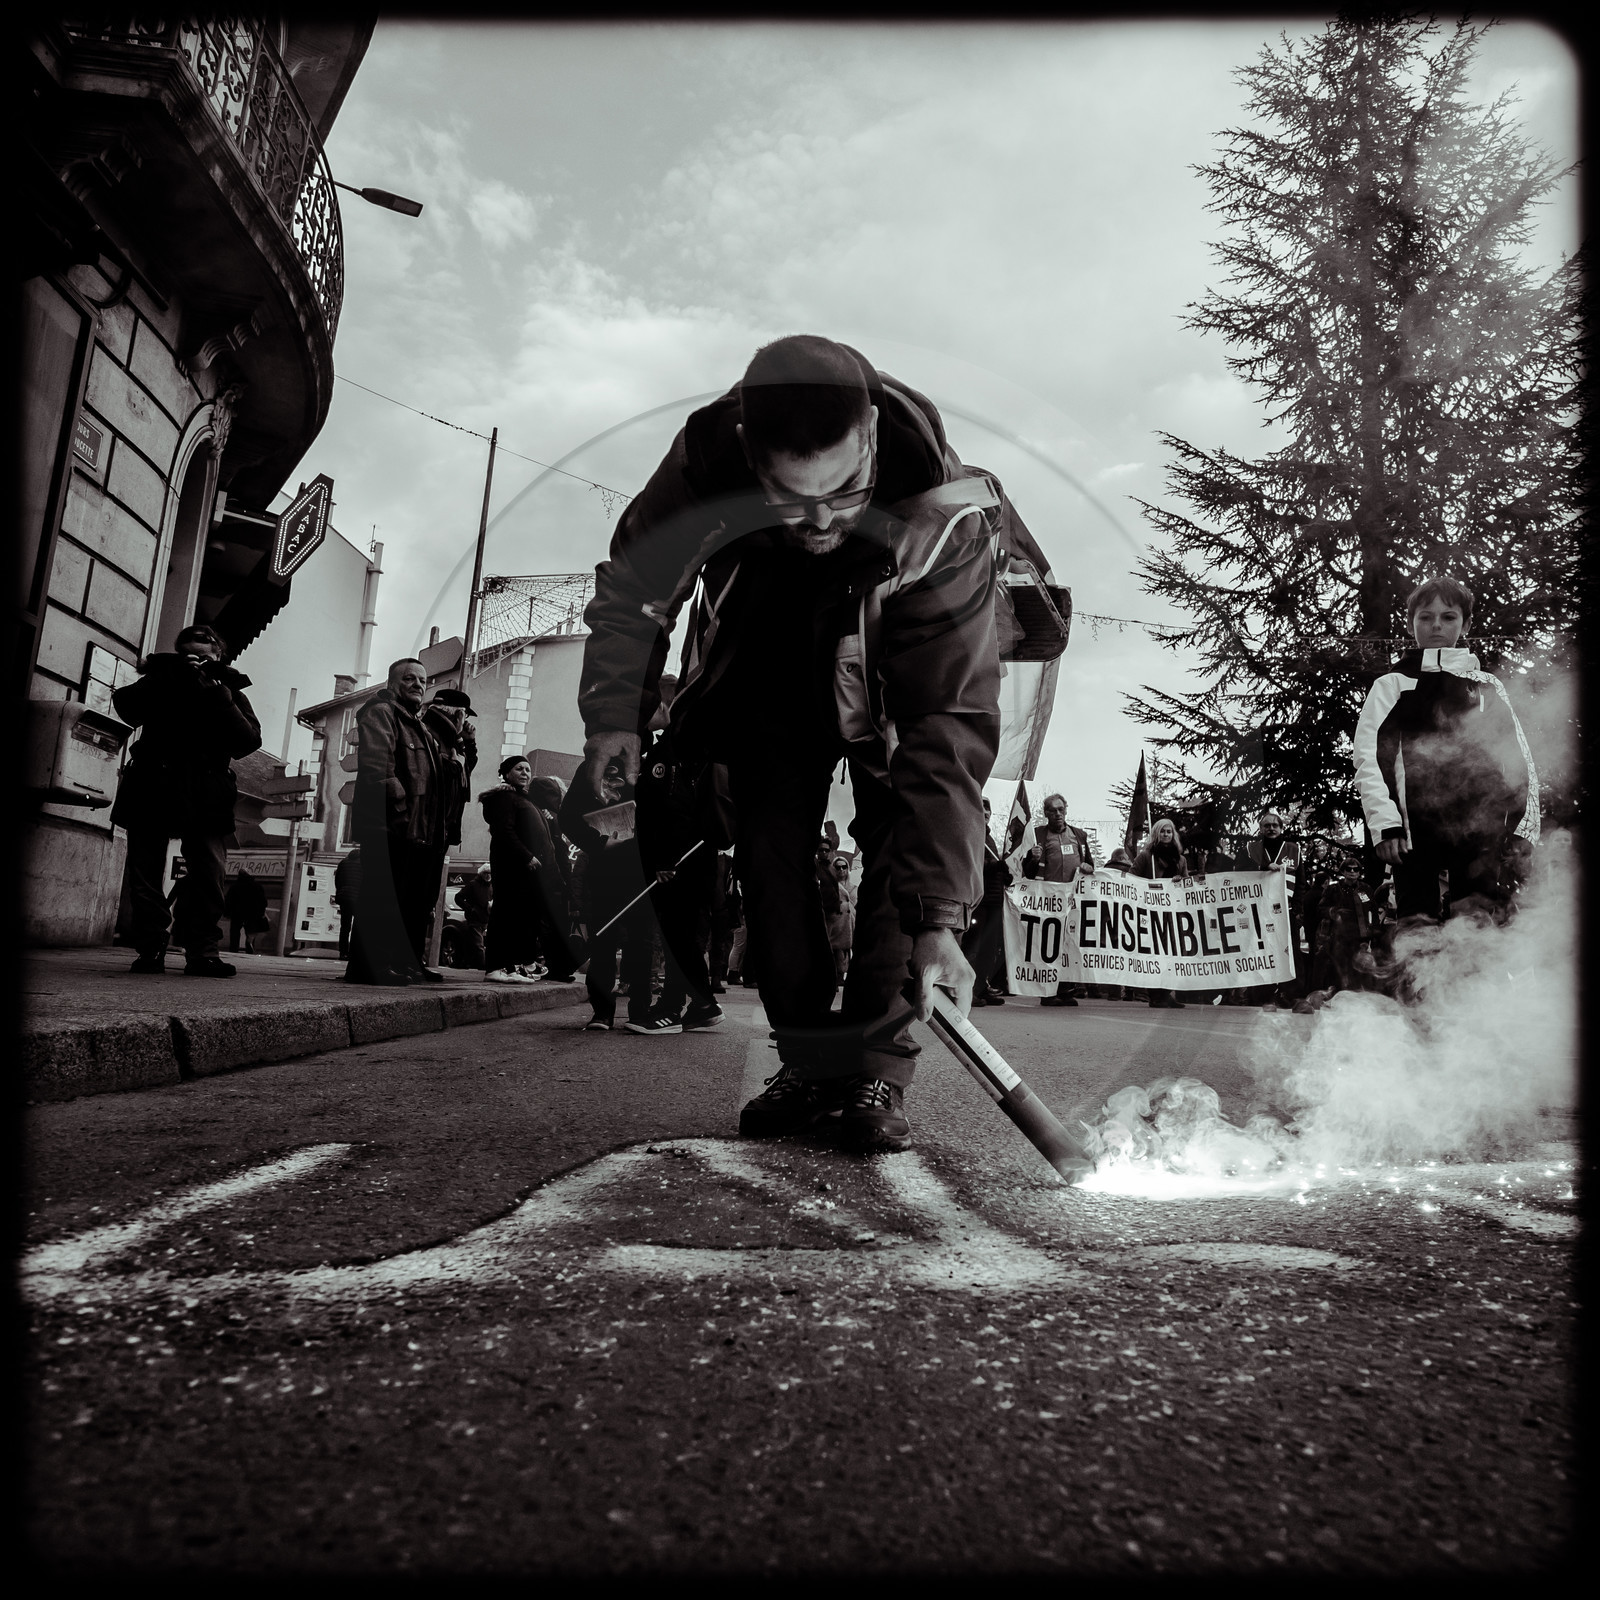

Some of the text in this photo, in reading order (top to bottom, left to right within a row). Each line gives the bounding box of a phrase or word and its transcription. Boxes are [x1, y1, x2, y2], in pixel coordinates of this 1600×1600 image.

[287, 503, 317, 553] TABAC
[1020, 894, 1063, 913] SALARIÉS
[1100, 882, 1138, 901] RETRAITÉS
[1144, 888, 1171, 907] JEUNES
[1185, 887, 1216, 906] PRIVÉS
[1221, 883, 1264, 902] D'EMPLOI
[1079, 900, 1241, 957] ENSEMBLE
[1015, 966, 1058, 984] SALAIRES
[1083, 953, 1125, 971] SERVICES
[1128, 958, 1161, 975] PUBLICS
[1174, 960, 1231, 977] PROTECTION
[1235, 955, 1276, 973] SOCIALE
